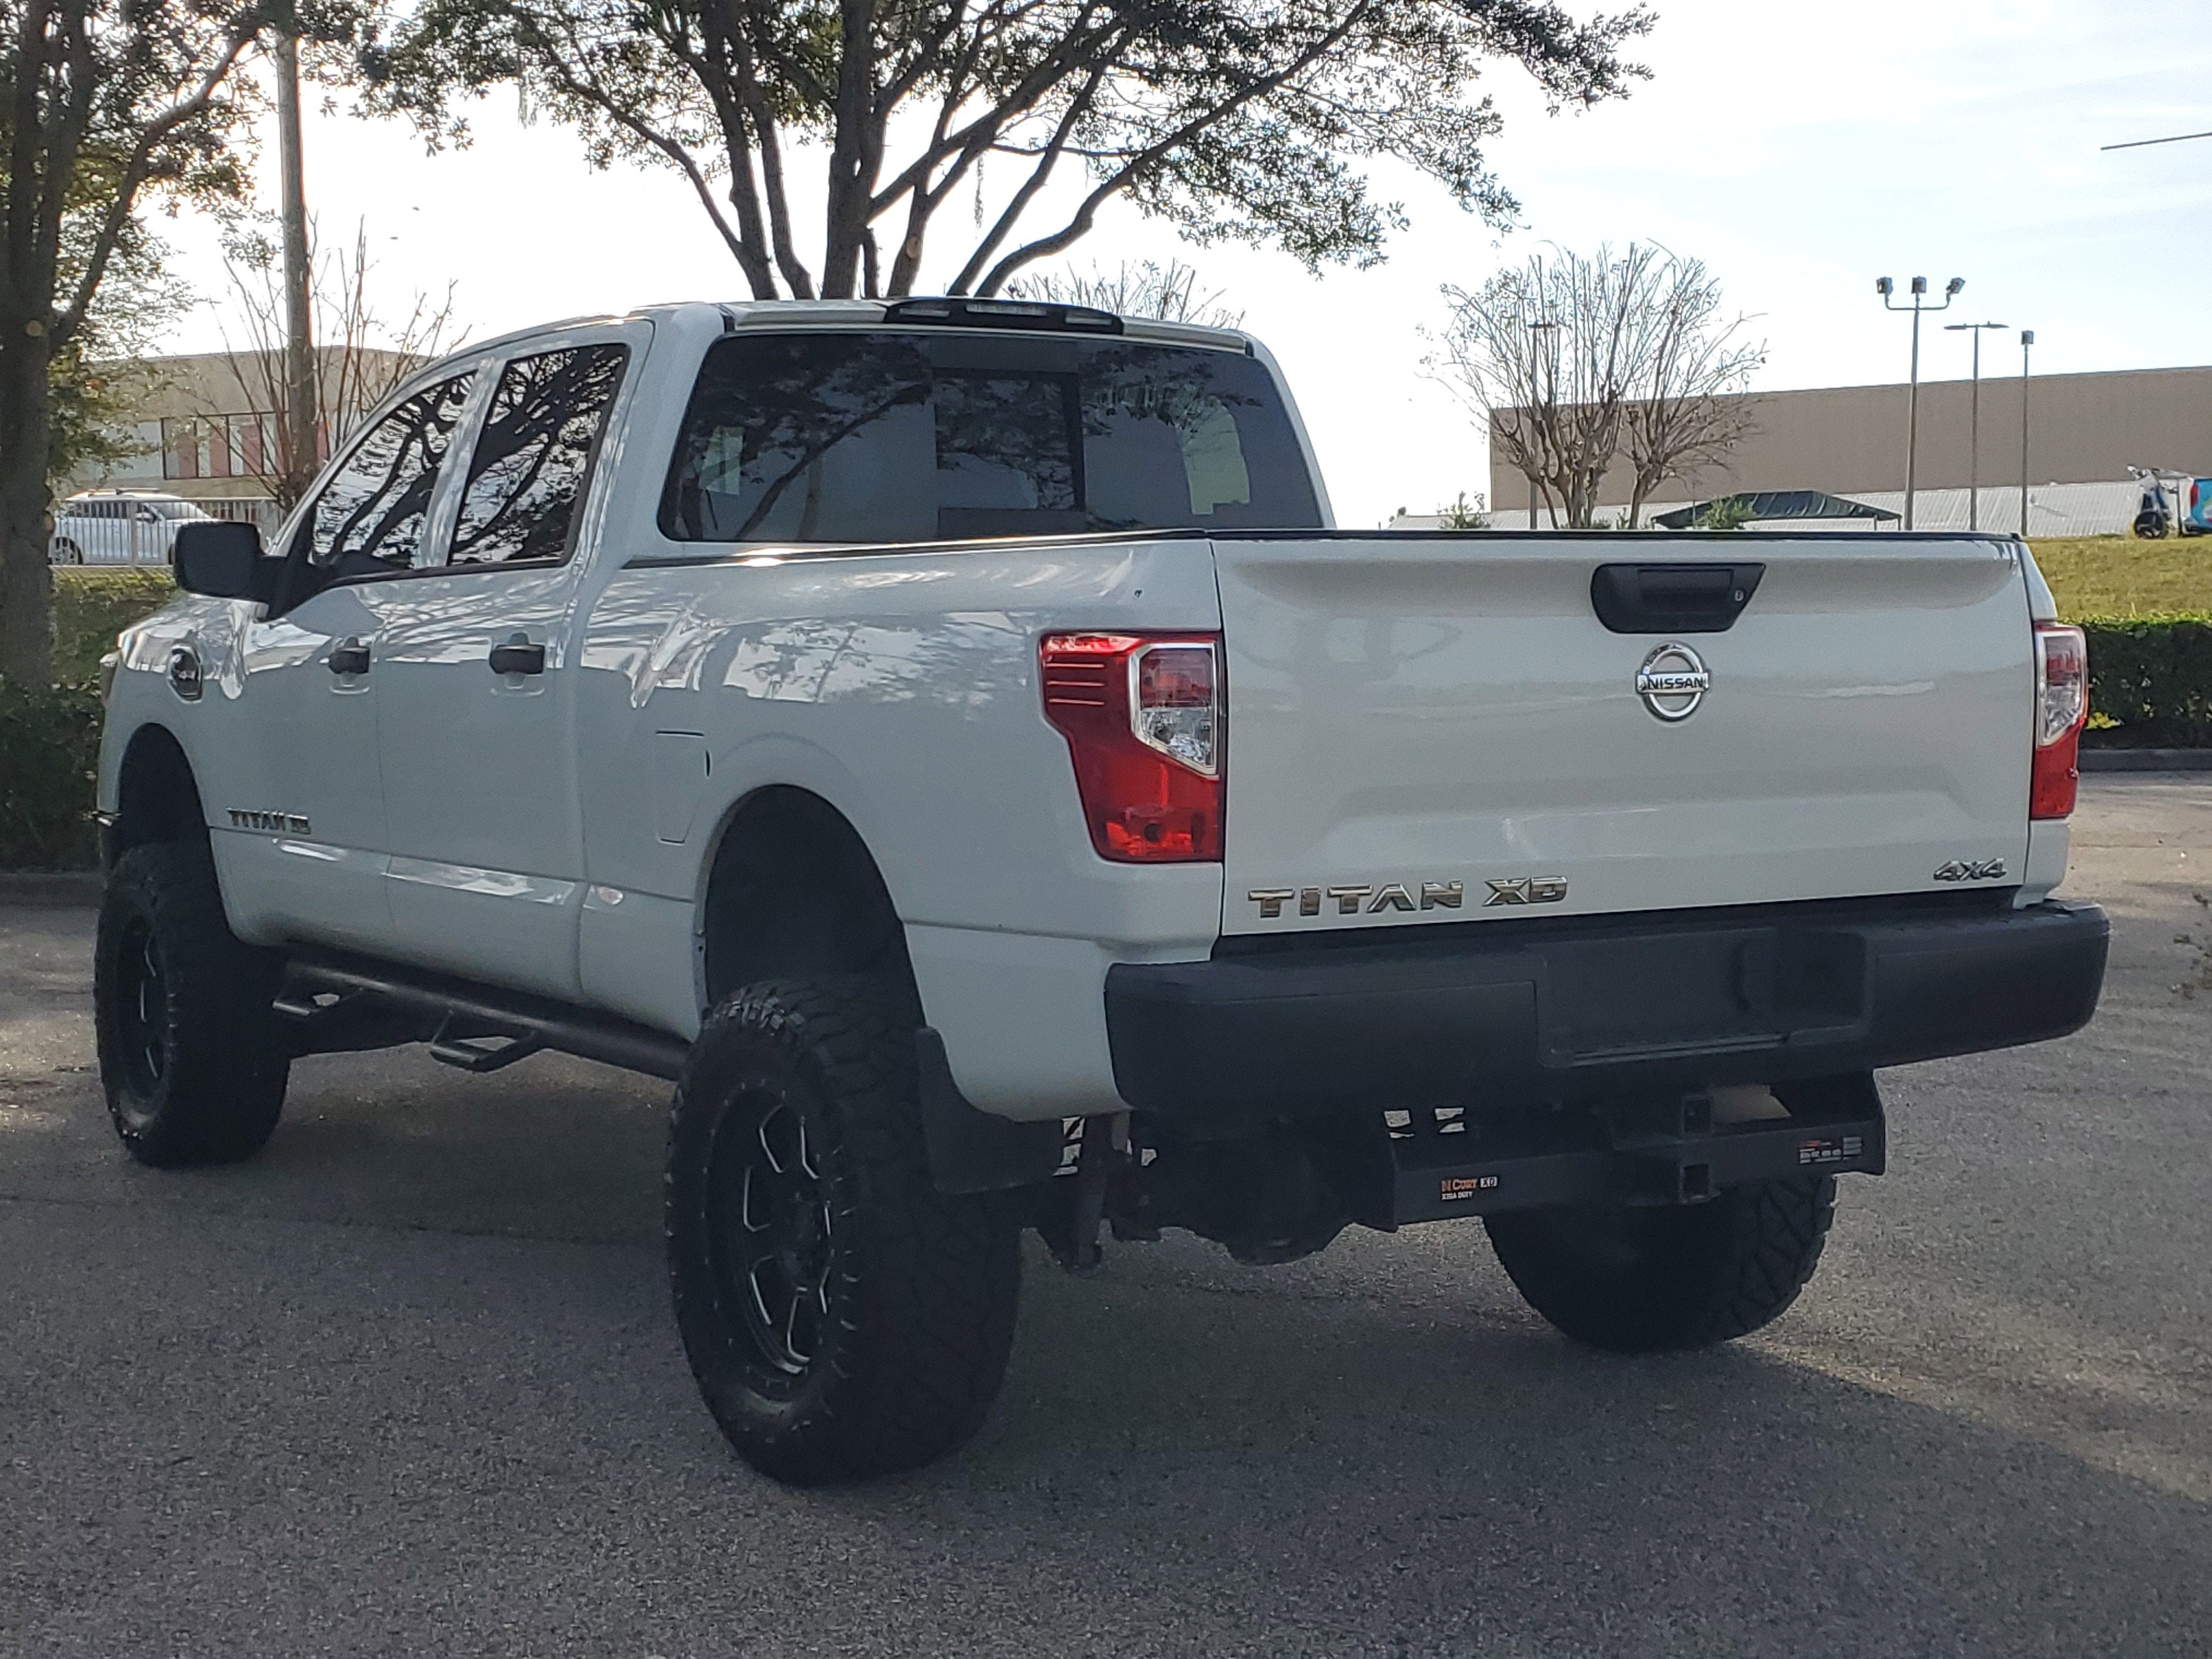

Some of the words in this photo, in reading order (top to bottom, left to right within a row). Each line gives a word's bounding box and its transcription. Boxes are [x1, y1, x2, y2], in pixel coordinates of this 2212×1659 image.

[1647, 676, 1703, 690] NISSAN
[1249, 880, 1463, 918] TITAN
[1482, 876, 1568, 907] XD
[1482, 1177, 1497, 1187] XD
